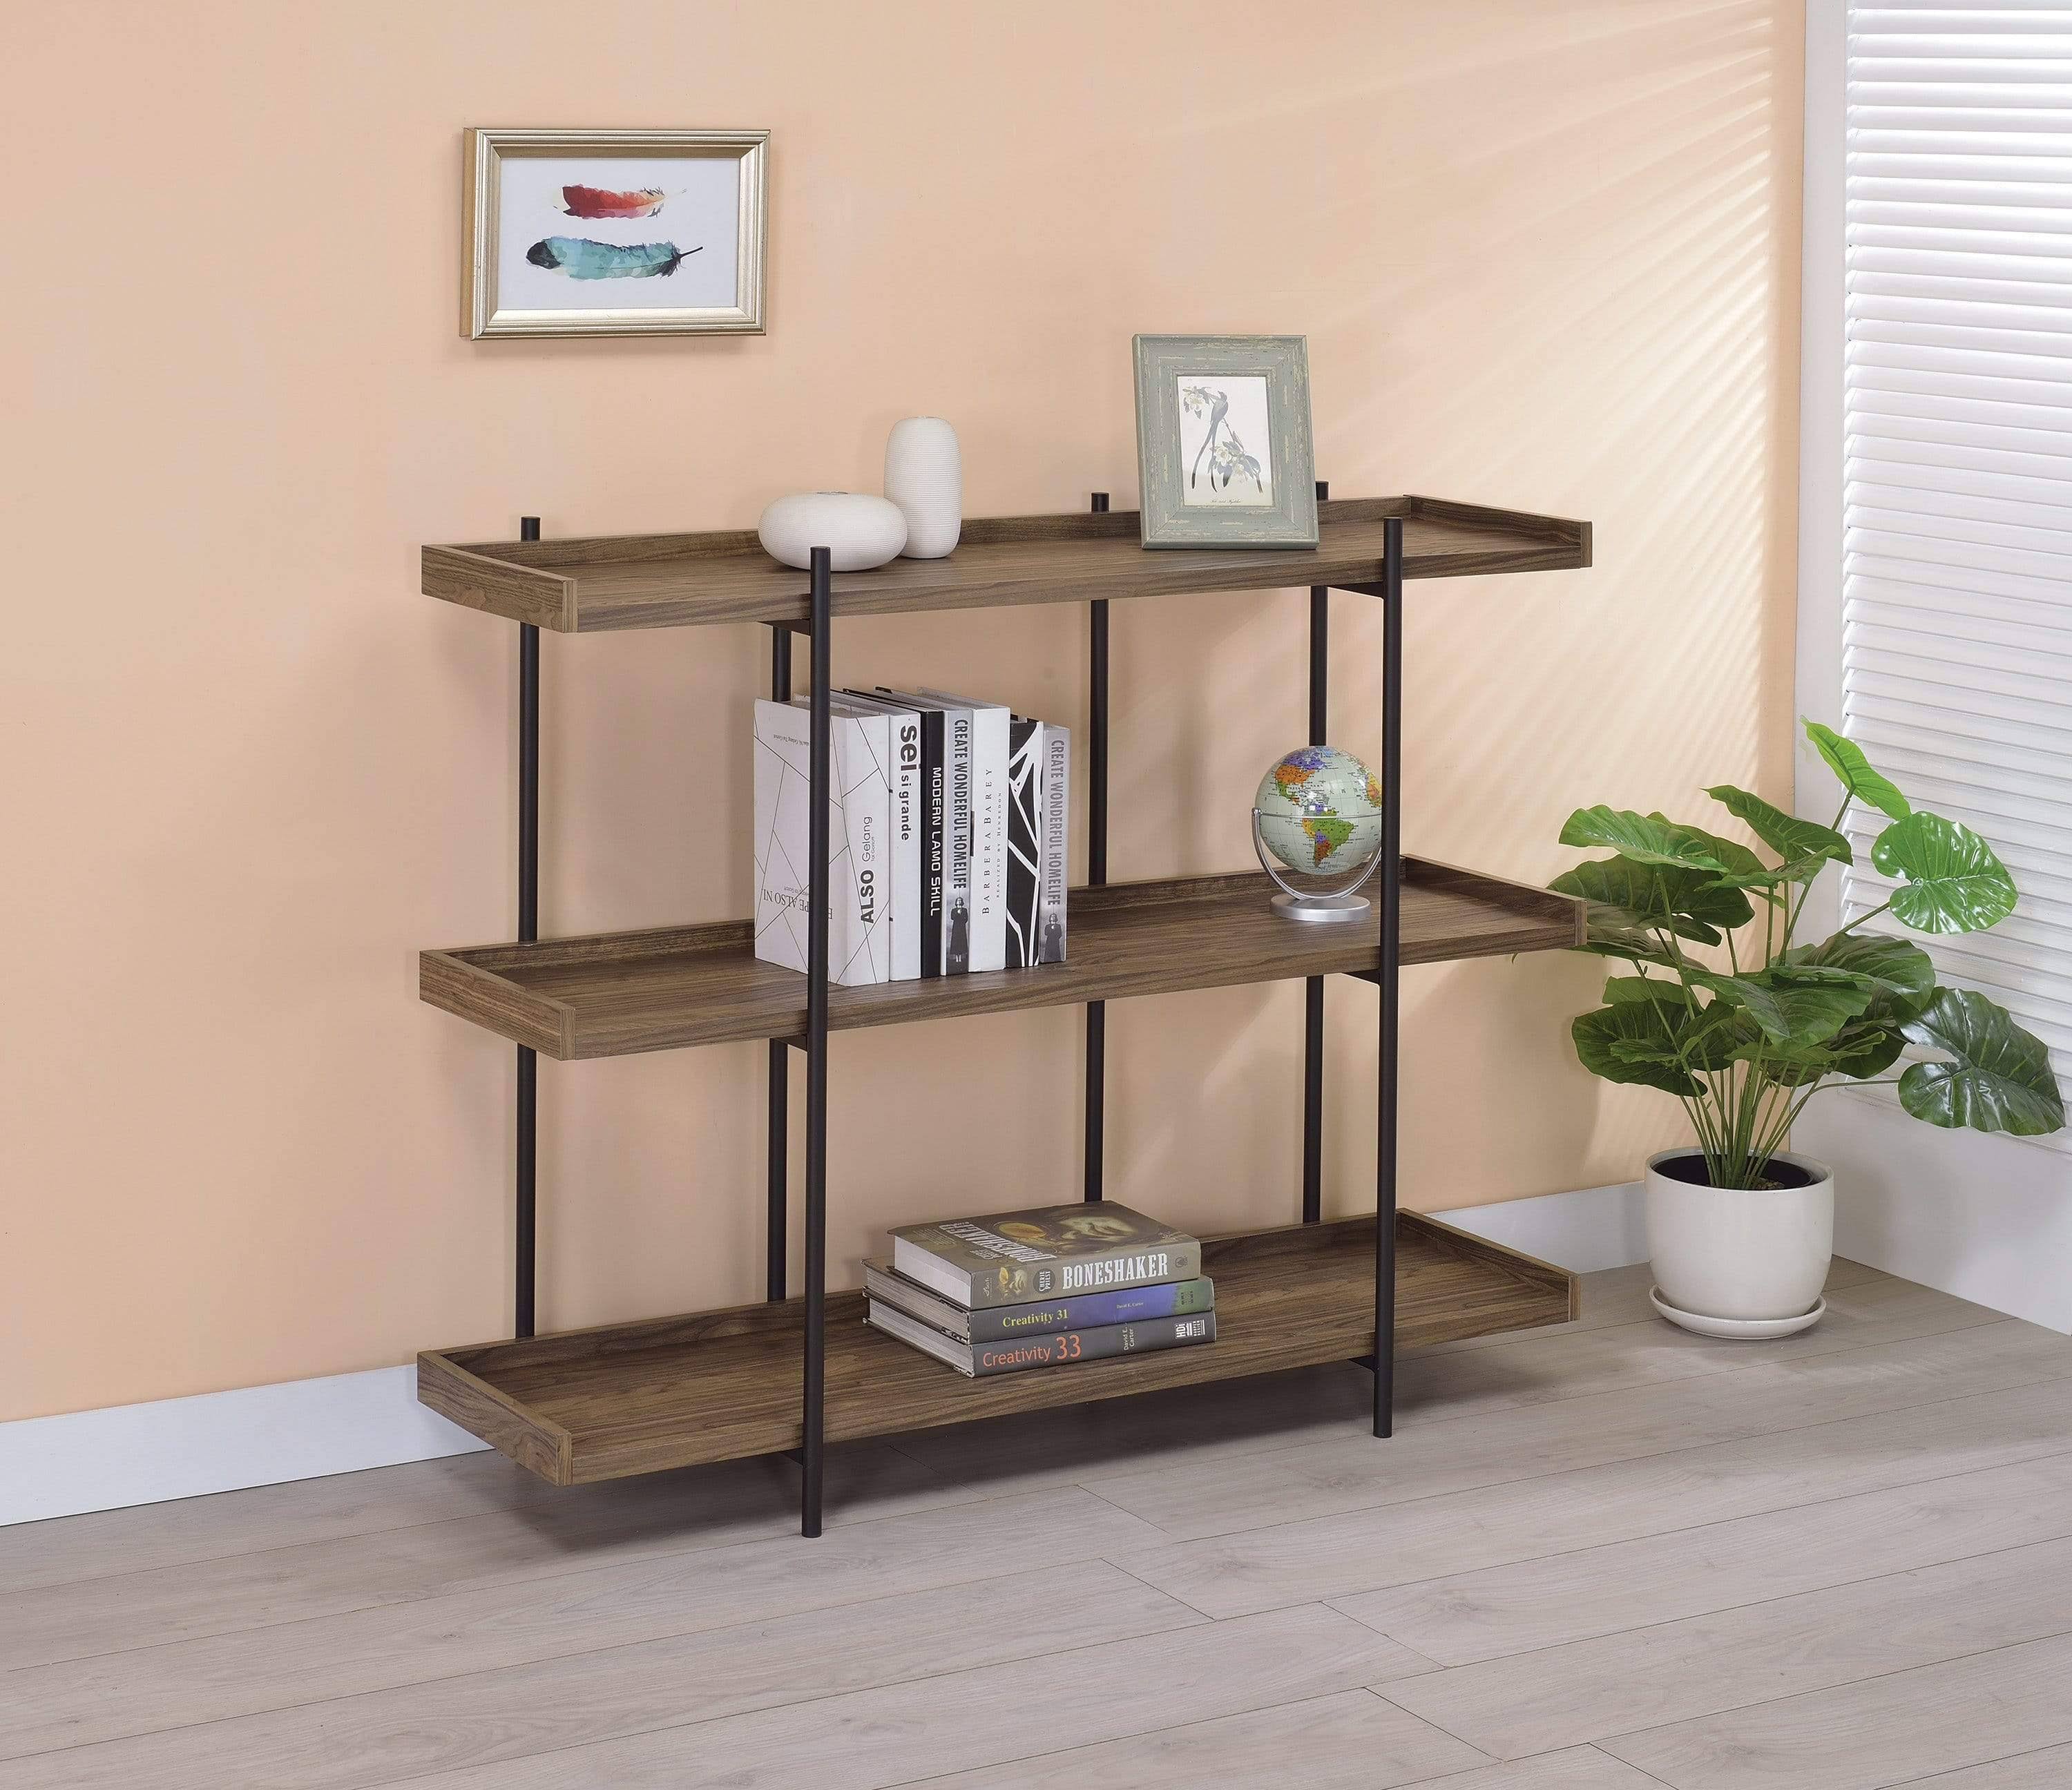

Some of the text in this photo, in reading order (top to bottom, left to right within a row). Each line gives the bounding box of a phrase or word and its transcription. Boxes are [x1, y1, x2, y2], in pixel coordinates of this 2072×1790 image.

[901, 775, 912, 787] si
[932, 767, 942, 826] MODERN
[899, 791, 912, 840] grande
[953, 719, 968, 889] CREATE WONDERFUL HOMELIFE
[1047, 740, 1064, 906] CREATE WONDERFUL HOMELIFE
[982, 769, 992, 914] BARBERA BAREY
[861, 816, 874, 924] ALSO Gelang
[774, 892, 797, 908] ALSO
[930, 877, 941, 916] SKILL
[1062, 1253, 1169, 1289] BONESHAKER
[1003, 1309, 1068, 1327] Creativity 31
[983, 1334, 1082, 1367] Creativity 33
